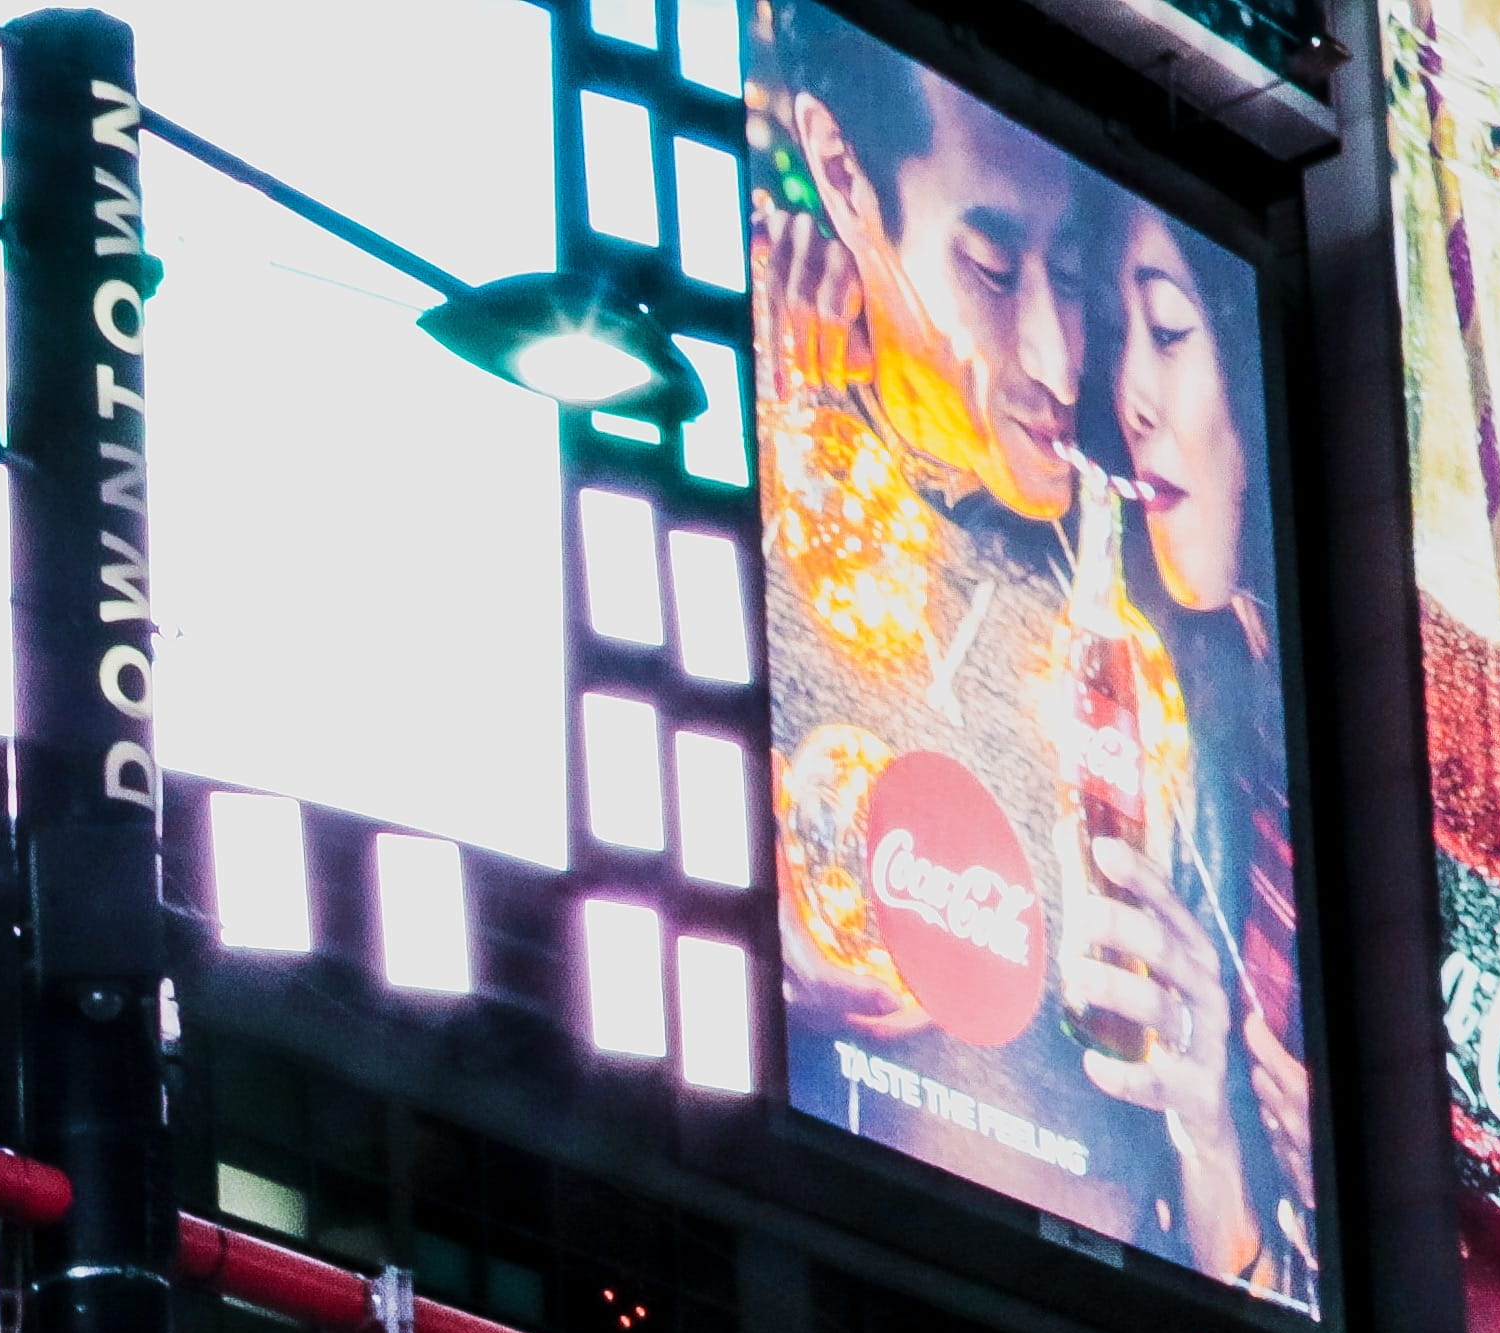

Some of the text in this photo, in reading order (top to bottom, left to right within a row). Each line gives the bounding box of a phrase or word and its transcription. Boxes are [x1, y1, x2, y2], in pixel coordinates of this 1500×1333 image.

[89, 80, 156, 808] DOWNTOWN
[834, 1040, 922, 1108] TASTE
[921, 1076, 980, 1129] THE
